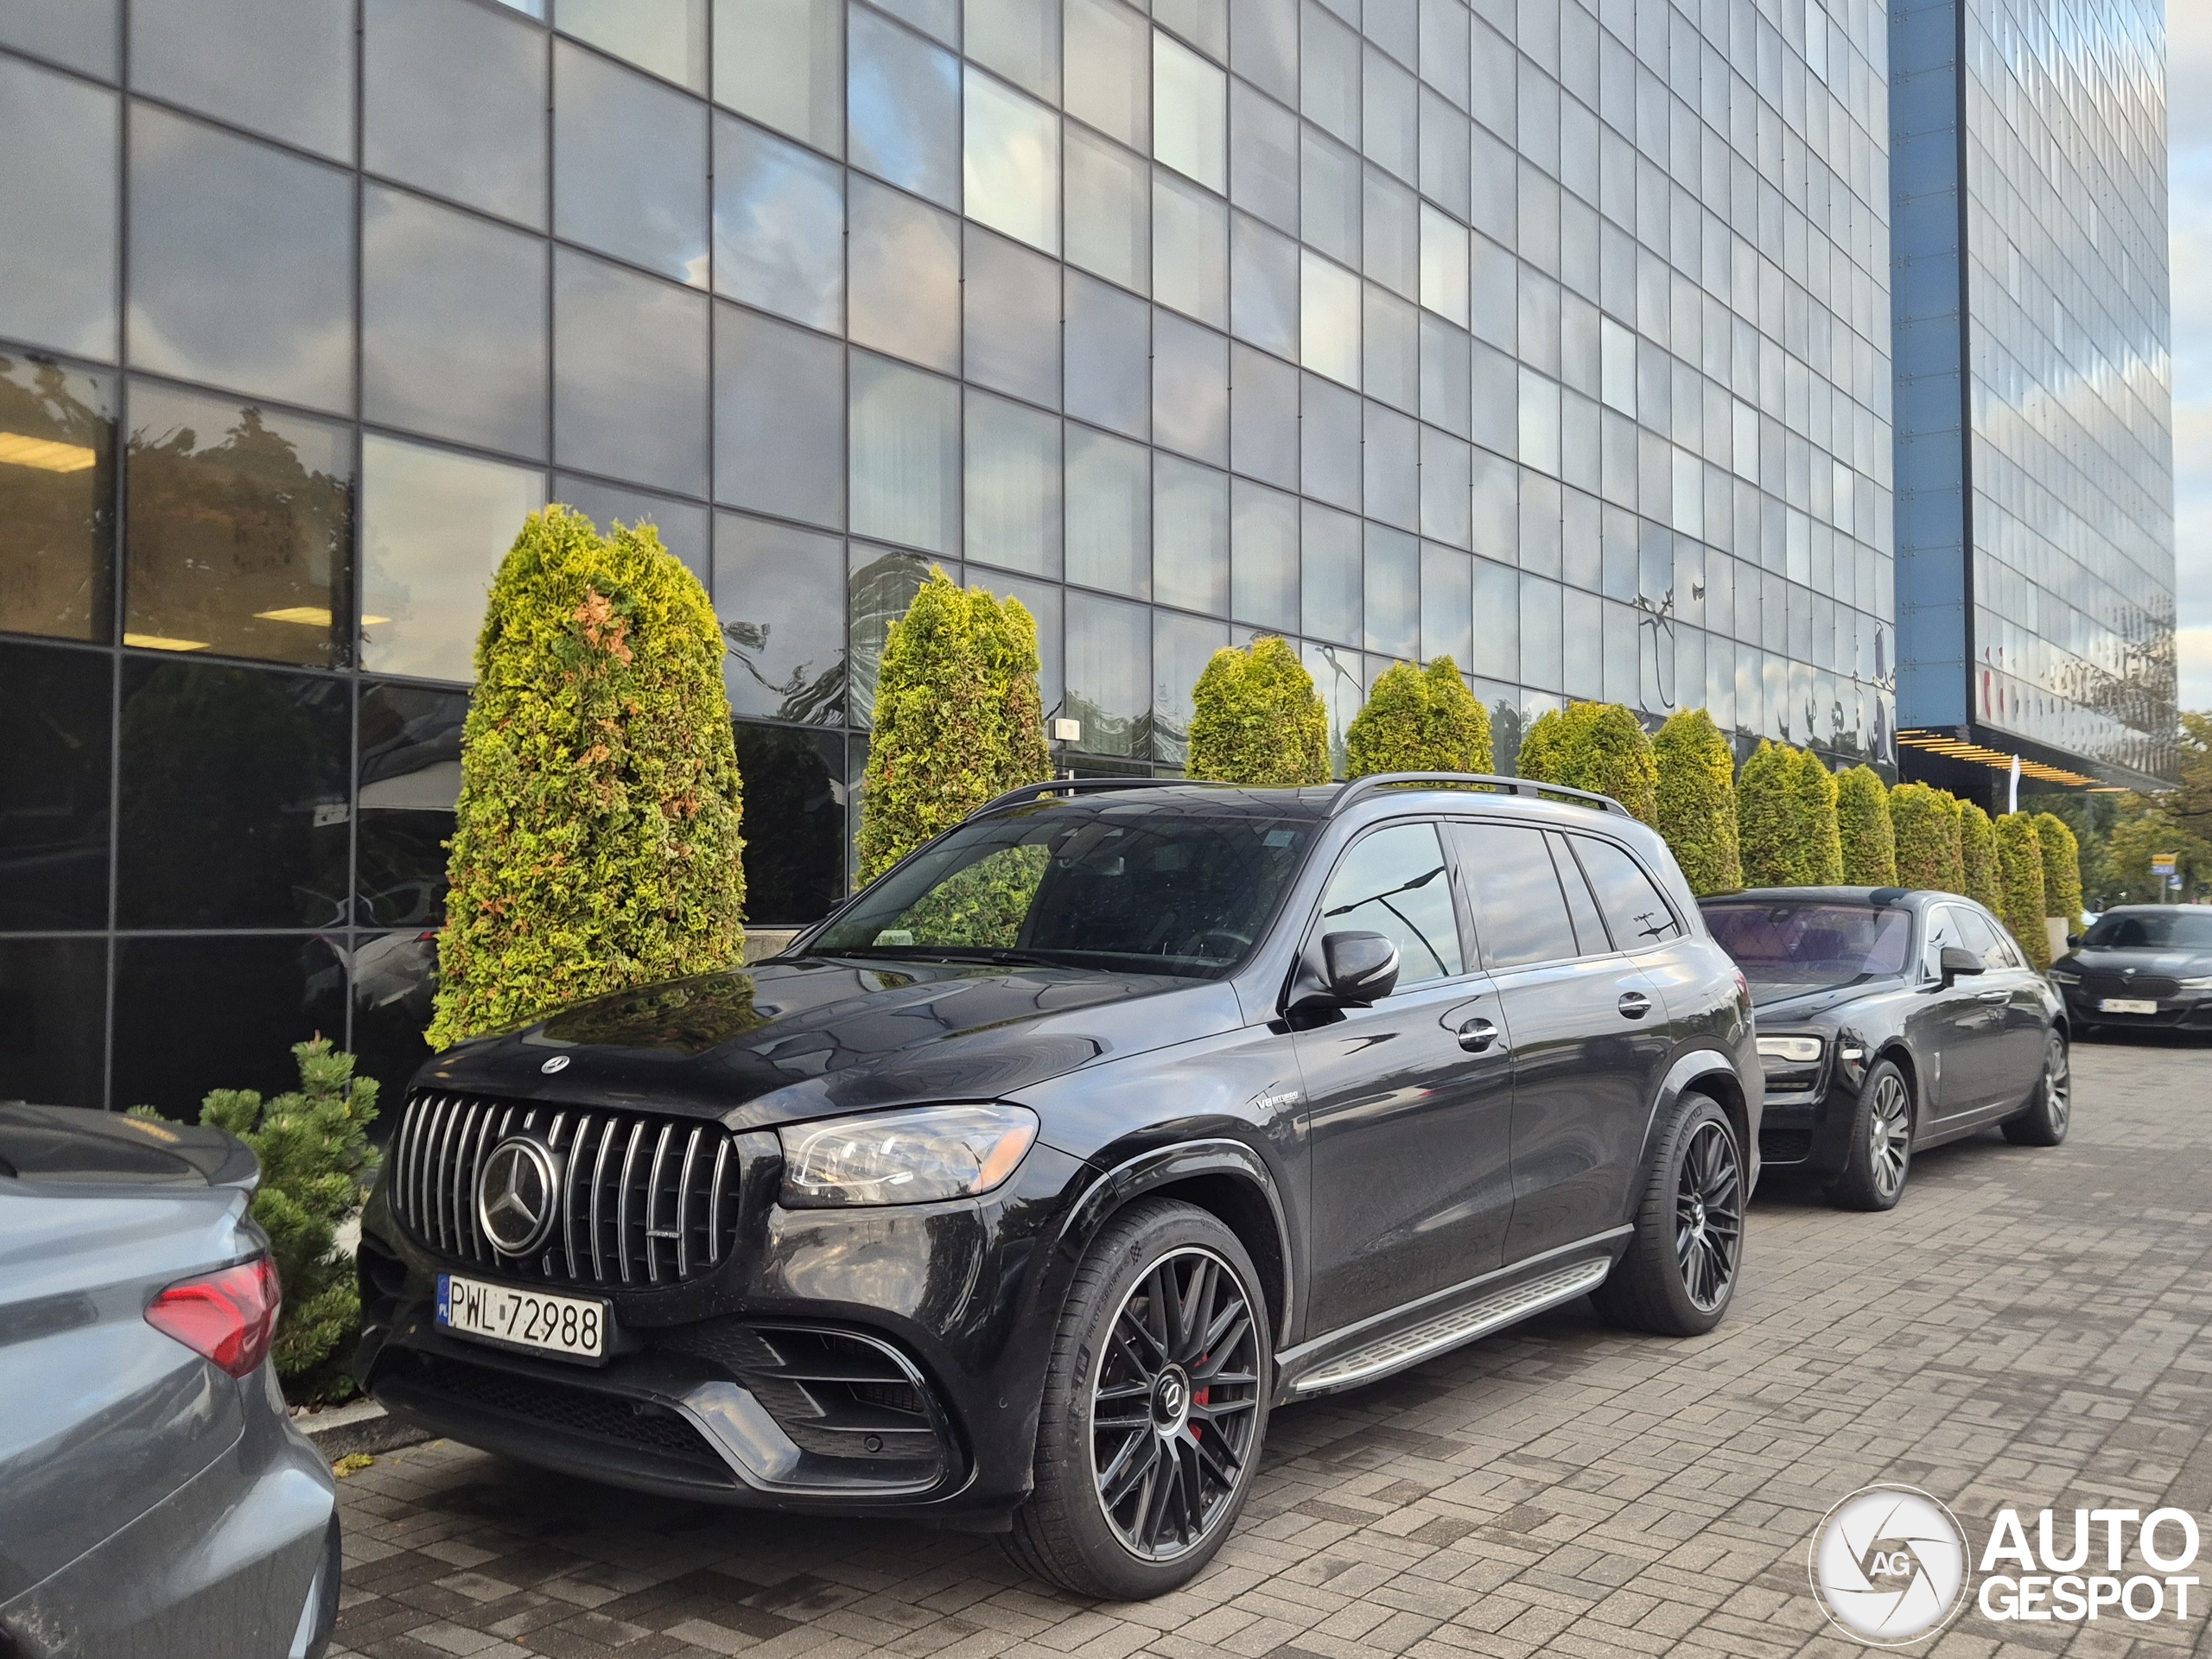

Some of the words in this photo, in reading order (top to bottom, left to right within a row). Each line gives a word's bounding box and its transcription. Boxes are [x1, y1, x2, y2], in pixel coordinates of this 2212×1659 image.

[1256, 1097, 1273, 1109] V8
[450, 1281, 495, 1332] PWL
[506, 1294, 598, 1351] 72988
[1088, 1304, 1102, 1338] PILOT
[1101, 1270, 1121, 1305] SPORT
